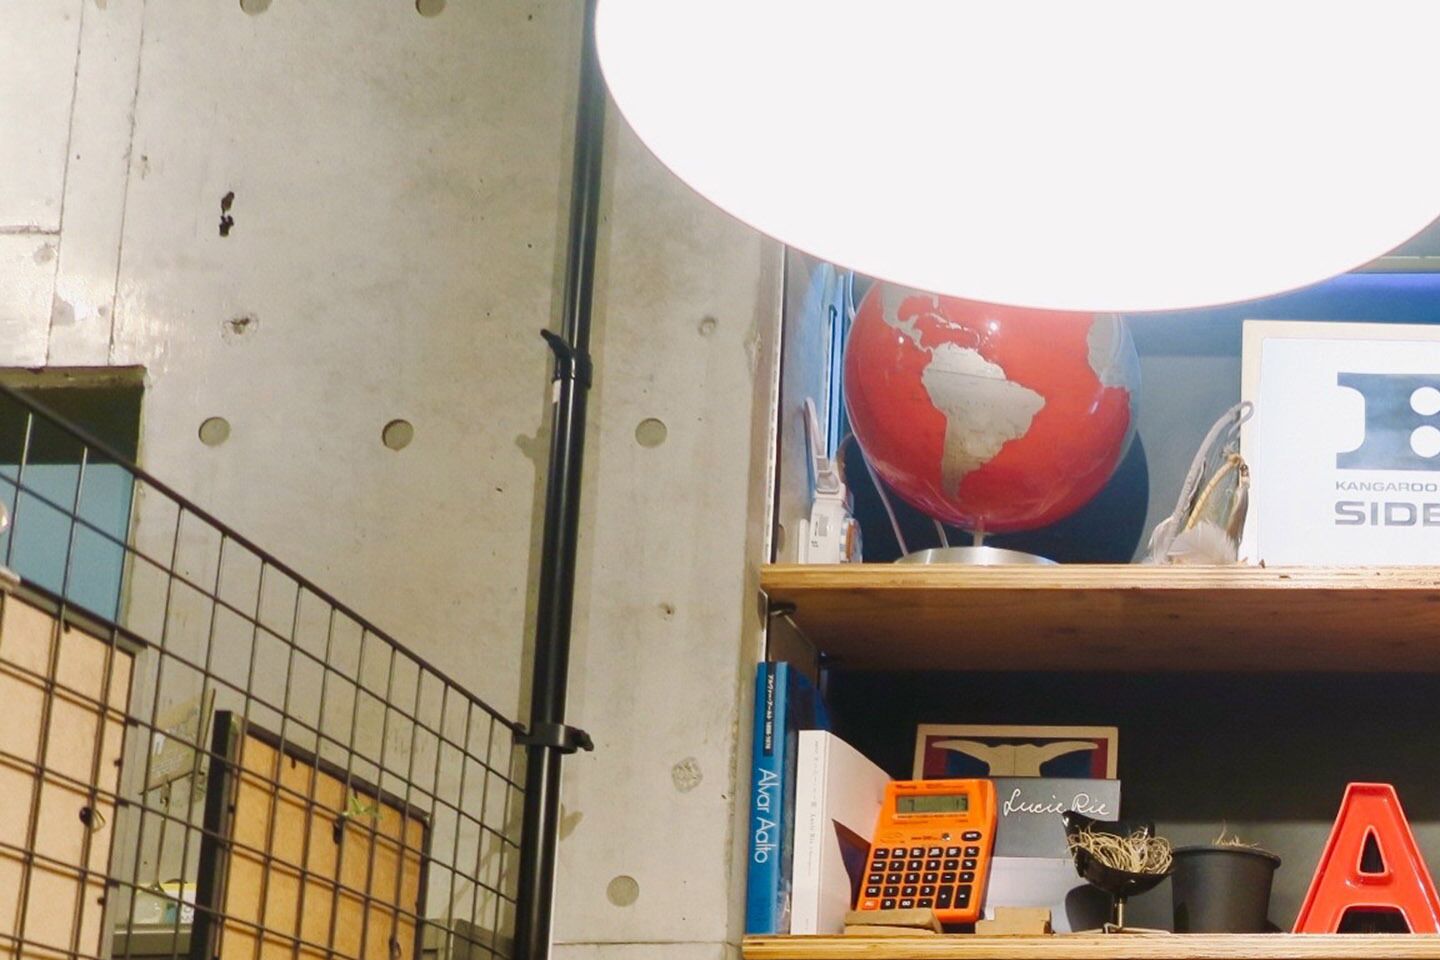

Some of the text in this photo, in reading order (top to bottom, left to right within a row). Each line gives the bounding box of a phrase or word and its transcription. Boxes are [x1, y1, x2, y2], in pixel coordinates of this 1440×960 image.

[1336, 480, 1438, 493] KANGAROO
[754, 768, 778, 863] Alvar Aalto
[1003, 788, 1111, 817] Lucie Rie
